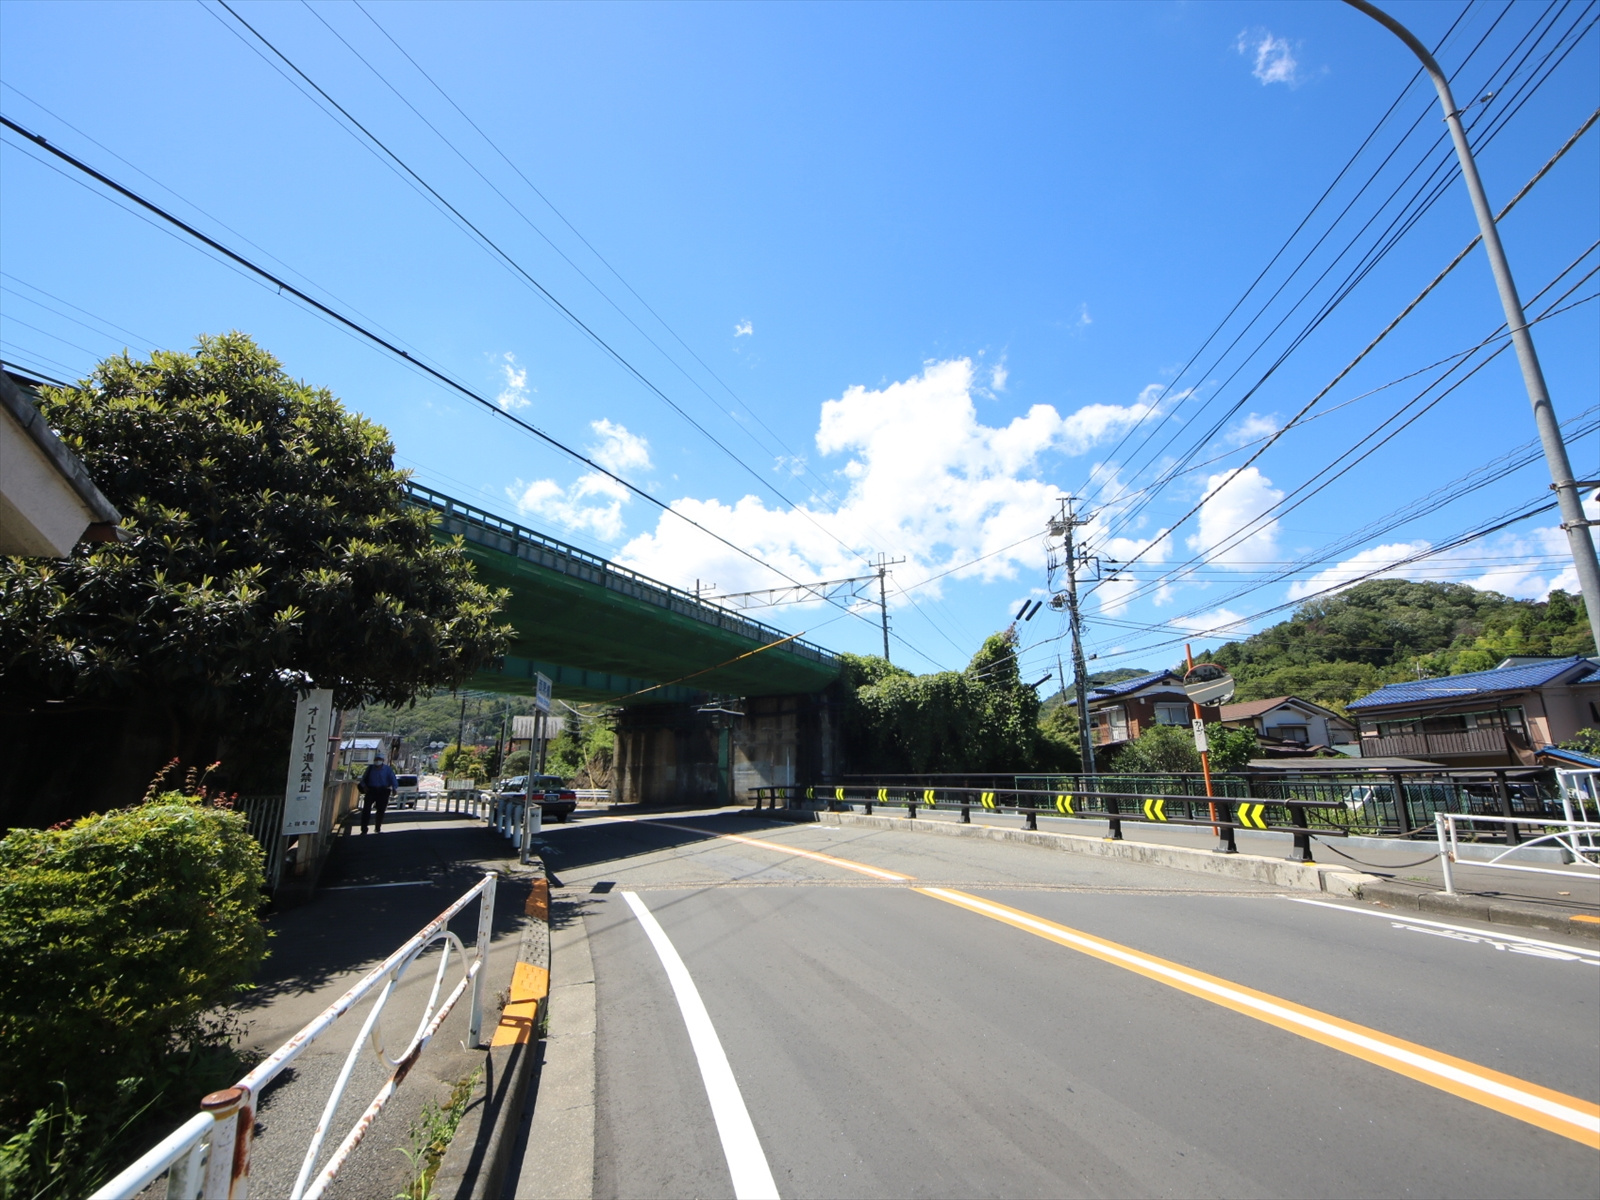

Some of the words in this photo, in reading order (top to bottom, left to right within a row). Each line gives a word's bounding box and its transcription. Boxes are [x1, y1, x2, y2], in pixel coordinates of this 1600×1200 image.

[299, 706, 319, 793] オートバイ進入禁止
